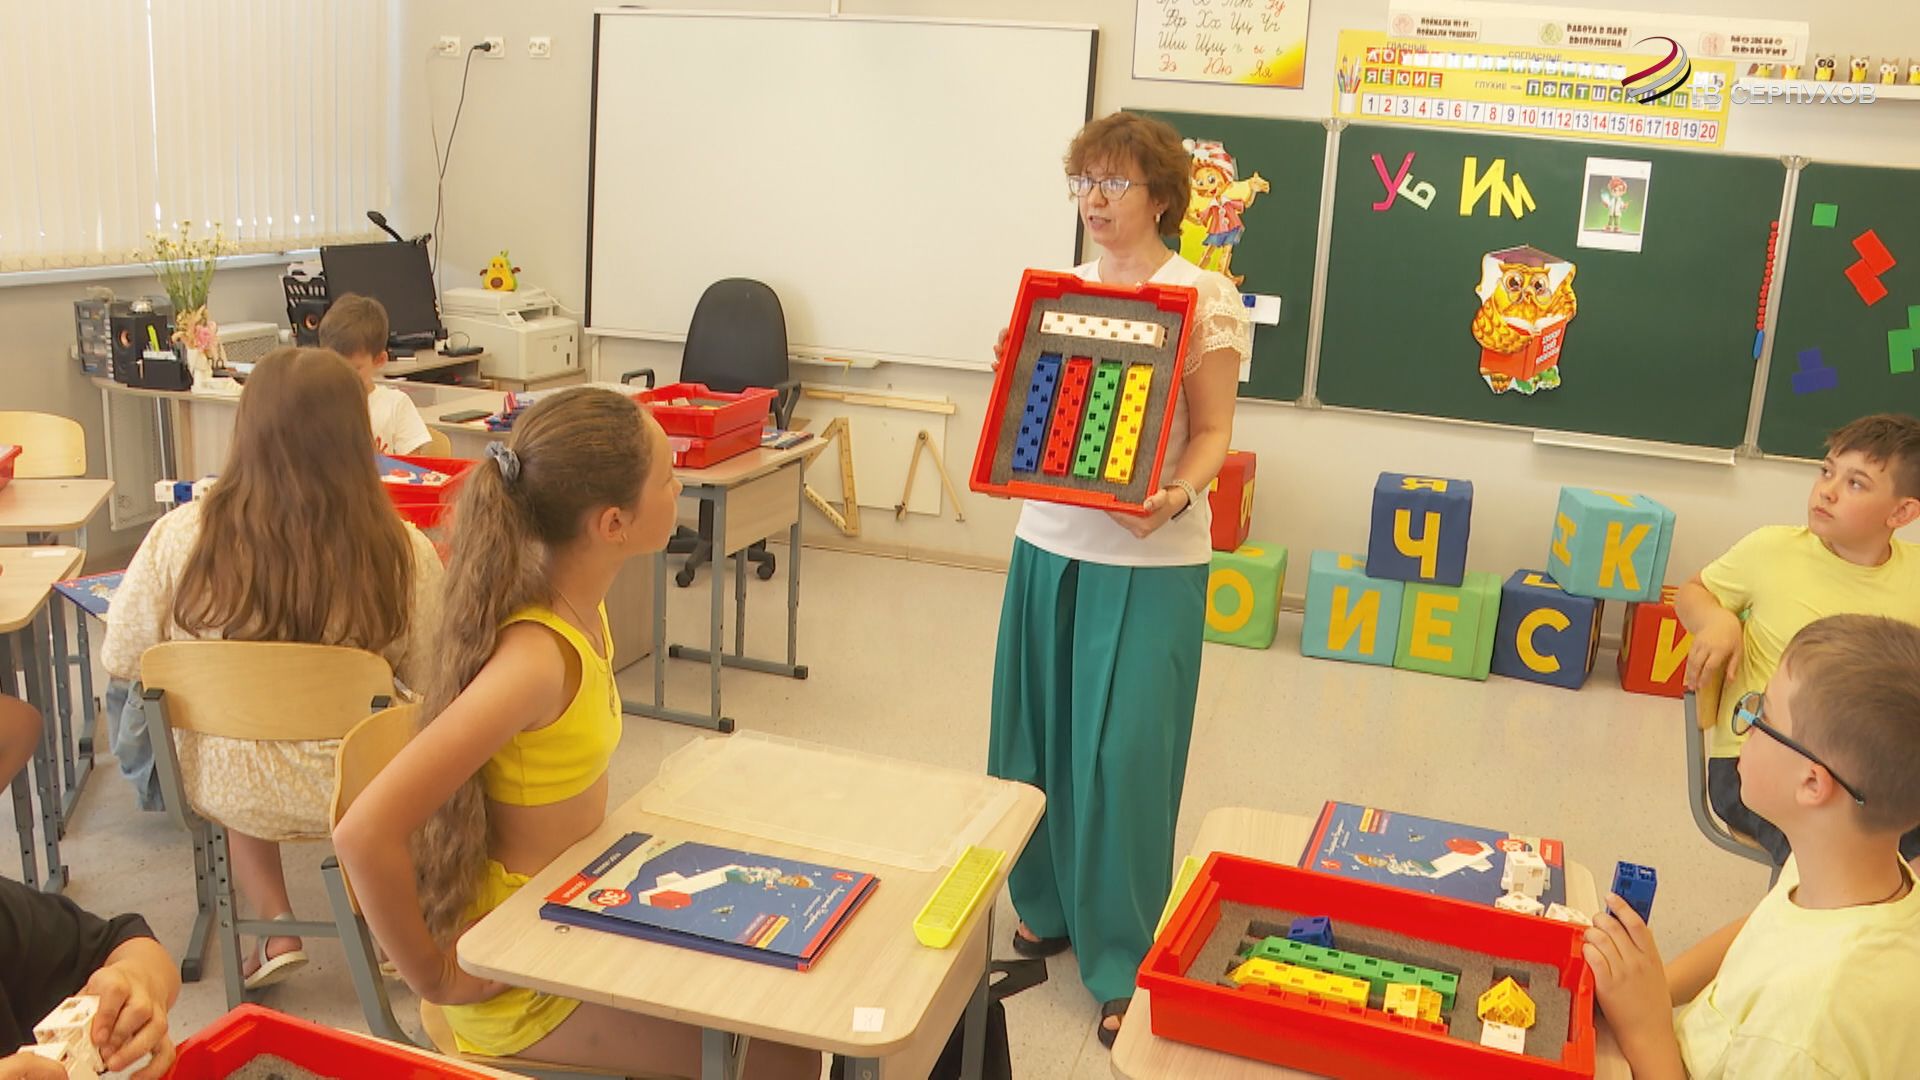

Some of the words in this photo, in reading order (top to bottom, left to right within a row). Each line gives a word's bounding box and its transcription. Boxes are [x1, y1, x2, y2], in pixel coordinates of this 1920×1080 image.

[1158, 31, 1186, 50] Шш
[1195, 33, 1226, 56] Щщ
[1196, 9, 1221, 29] Хх
[1231, 12, 1253, 35] Цц
[1262, 13, 1280, 32] Чч
[1159, 54, 1177, 72] Ээ
[1203, 57, 1232, 75] Юю
[1250, 59, 1272, 78] Яя
[1369, 97, 1374, 112] 1
[1384, 99, 1392, 113] 2
[1401, 99, 1409, 114] 3
[1419, 101, 1427, 115] 4
[1437, 102, 1444, 117] 5
[1454, 103, 1462, 118] 6
[1472, 105, 1480, 119] 7
[1489, 107, 1497, 121] 8
[1507, 108, 1515, 122] 9
[1522, 110, 1536, 124] 10
[1541, 110, 1553, 126] 11
[1557, 112, 1571, 128] 12
[1575, 113, 1589, 129] 13
[1593, 115, 1607, 130] 14
[1611, 116, 1625, 132] 15
[1629, 117, 1643, 133] 16
[1647, 118, 1661, 134] 17
[1665, 120, 1679, 136] 18
[1683, 121, 1697, 138] 19
[1700, 123, 1716, 139] 20
[1393, 508, 1441, 579] Ч
[1598, 521, 1653, 591] К
[1207, 568, 1254, 633] О
[1327, 584, 1380, 655] И
[1409, 592, 1459, 662] Е
[1516, 608, 1571, 673] С
